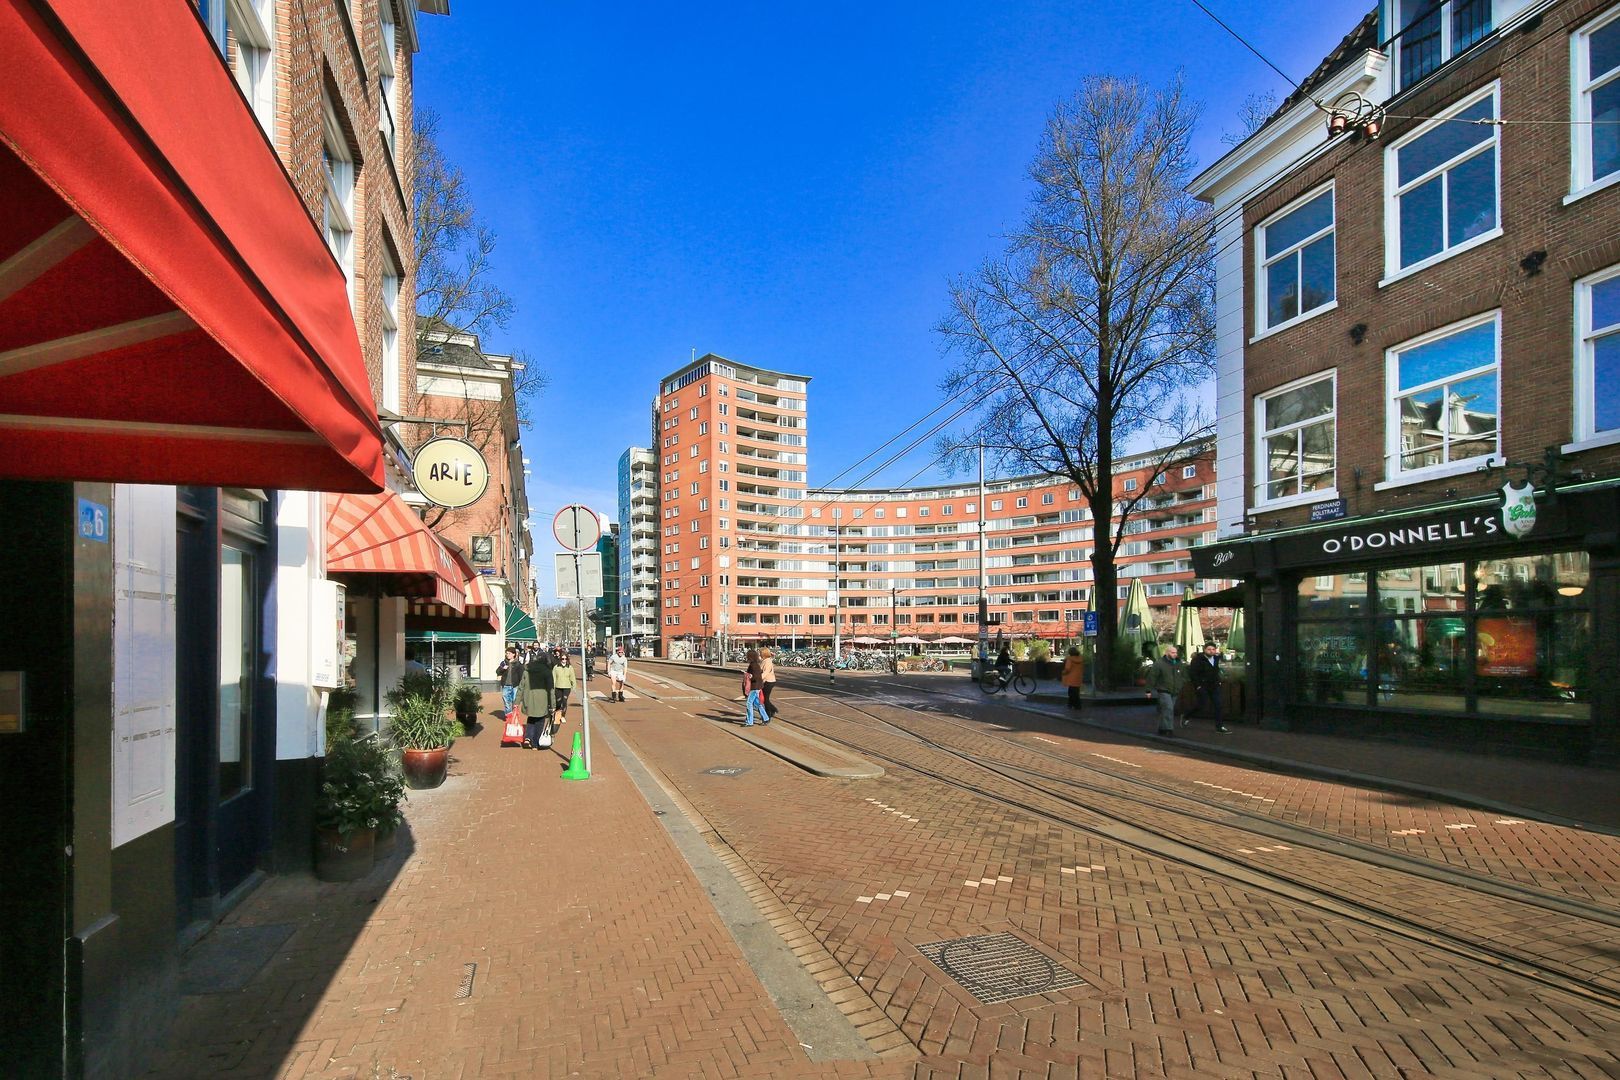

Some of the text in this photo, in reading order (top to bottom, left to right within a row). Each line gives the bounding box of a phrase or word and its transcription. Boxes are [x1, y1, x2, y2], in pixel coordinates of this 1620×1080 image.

[1312, 501, 1341, 510] FERDINAND
[1322, 516, 1498, 553] O'DONNELL'S
[1212, 550, 1234, 567] Bar
[1303, 635, 1357, 651] COFFEE
